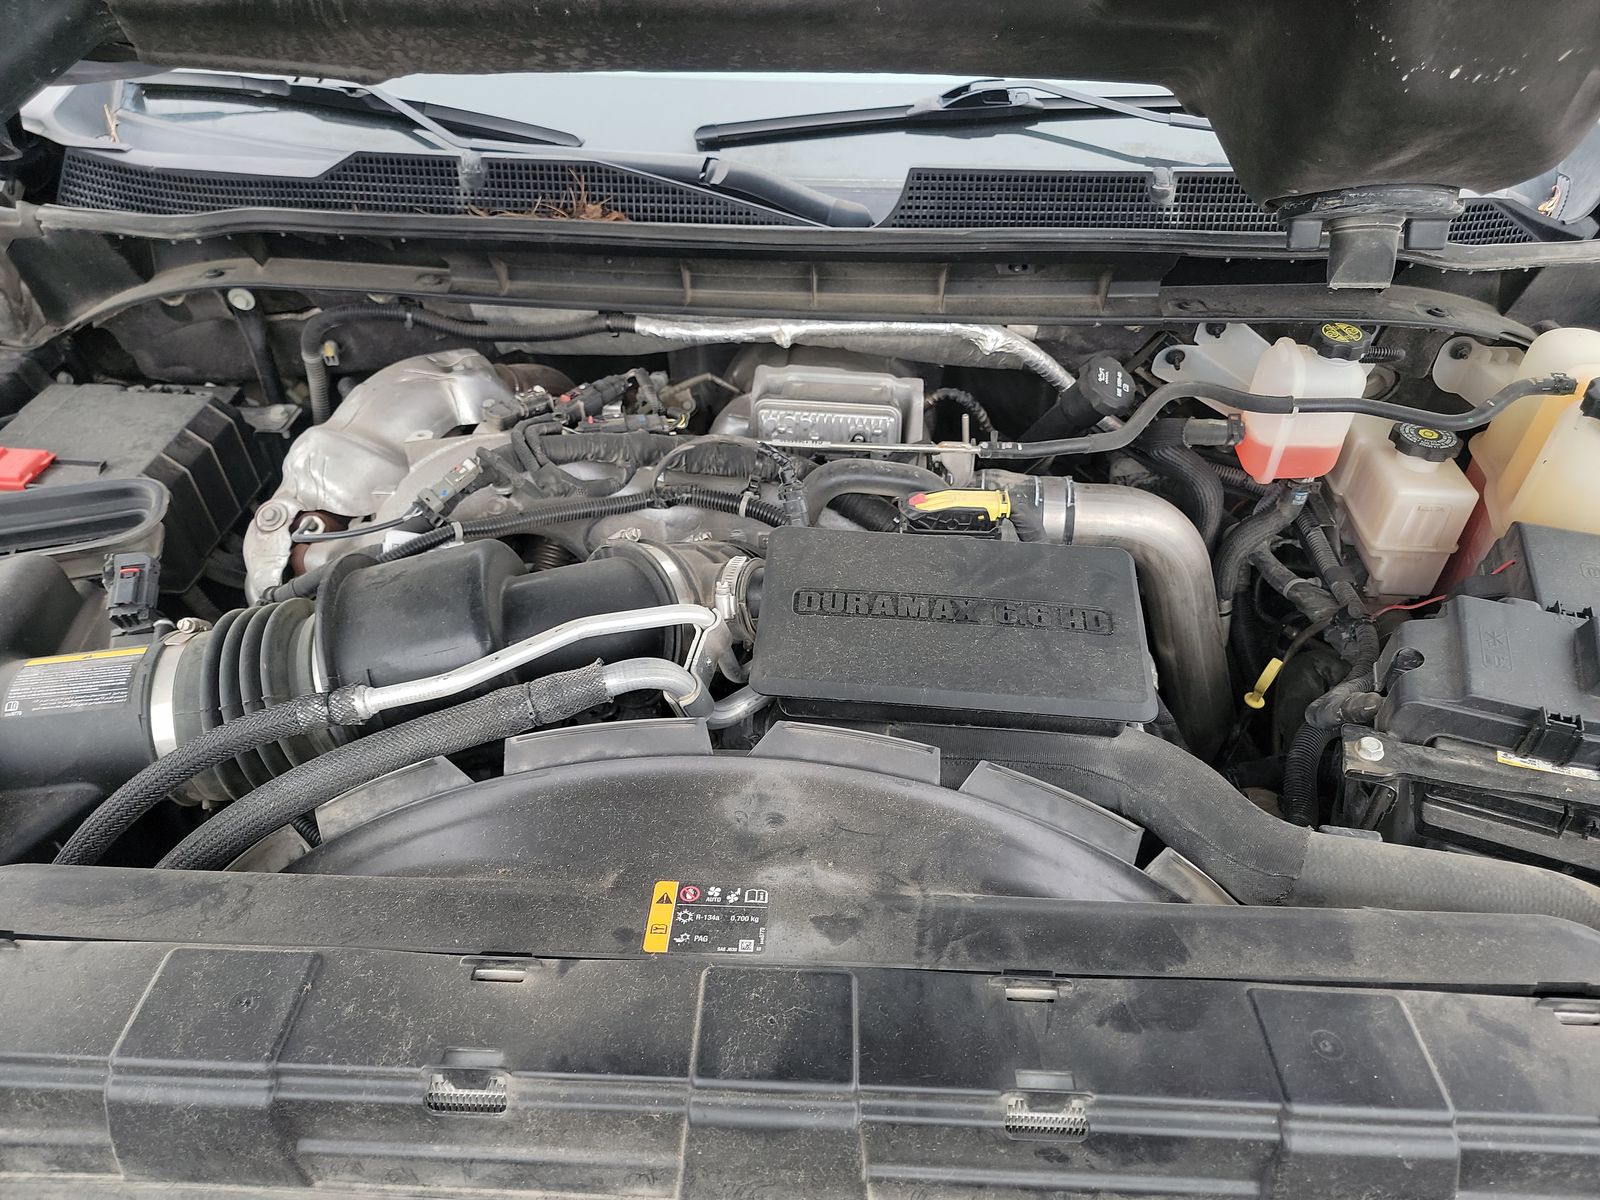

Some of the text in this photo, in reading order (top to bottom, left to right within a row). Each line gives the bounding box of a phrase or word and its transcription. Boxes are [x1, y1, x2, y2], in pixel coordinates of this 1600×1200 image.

[798, 591, 979, 623] DURAMAX
[1058, 606, 1112, 631] HD
[750, 915, 760, 923] kg
